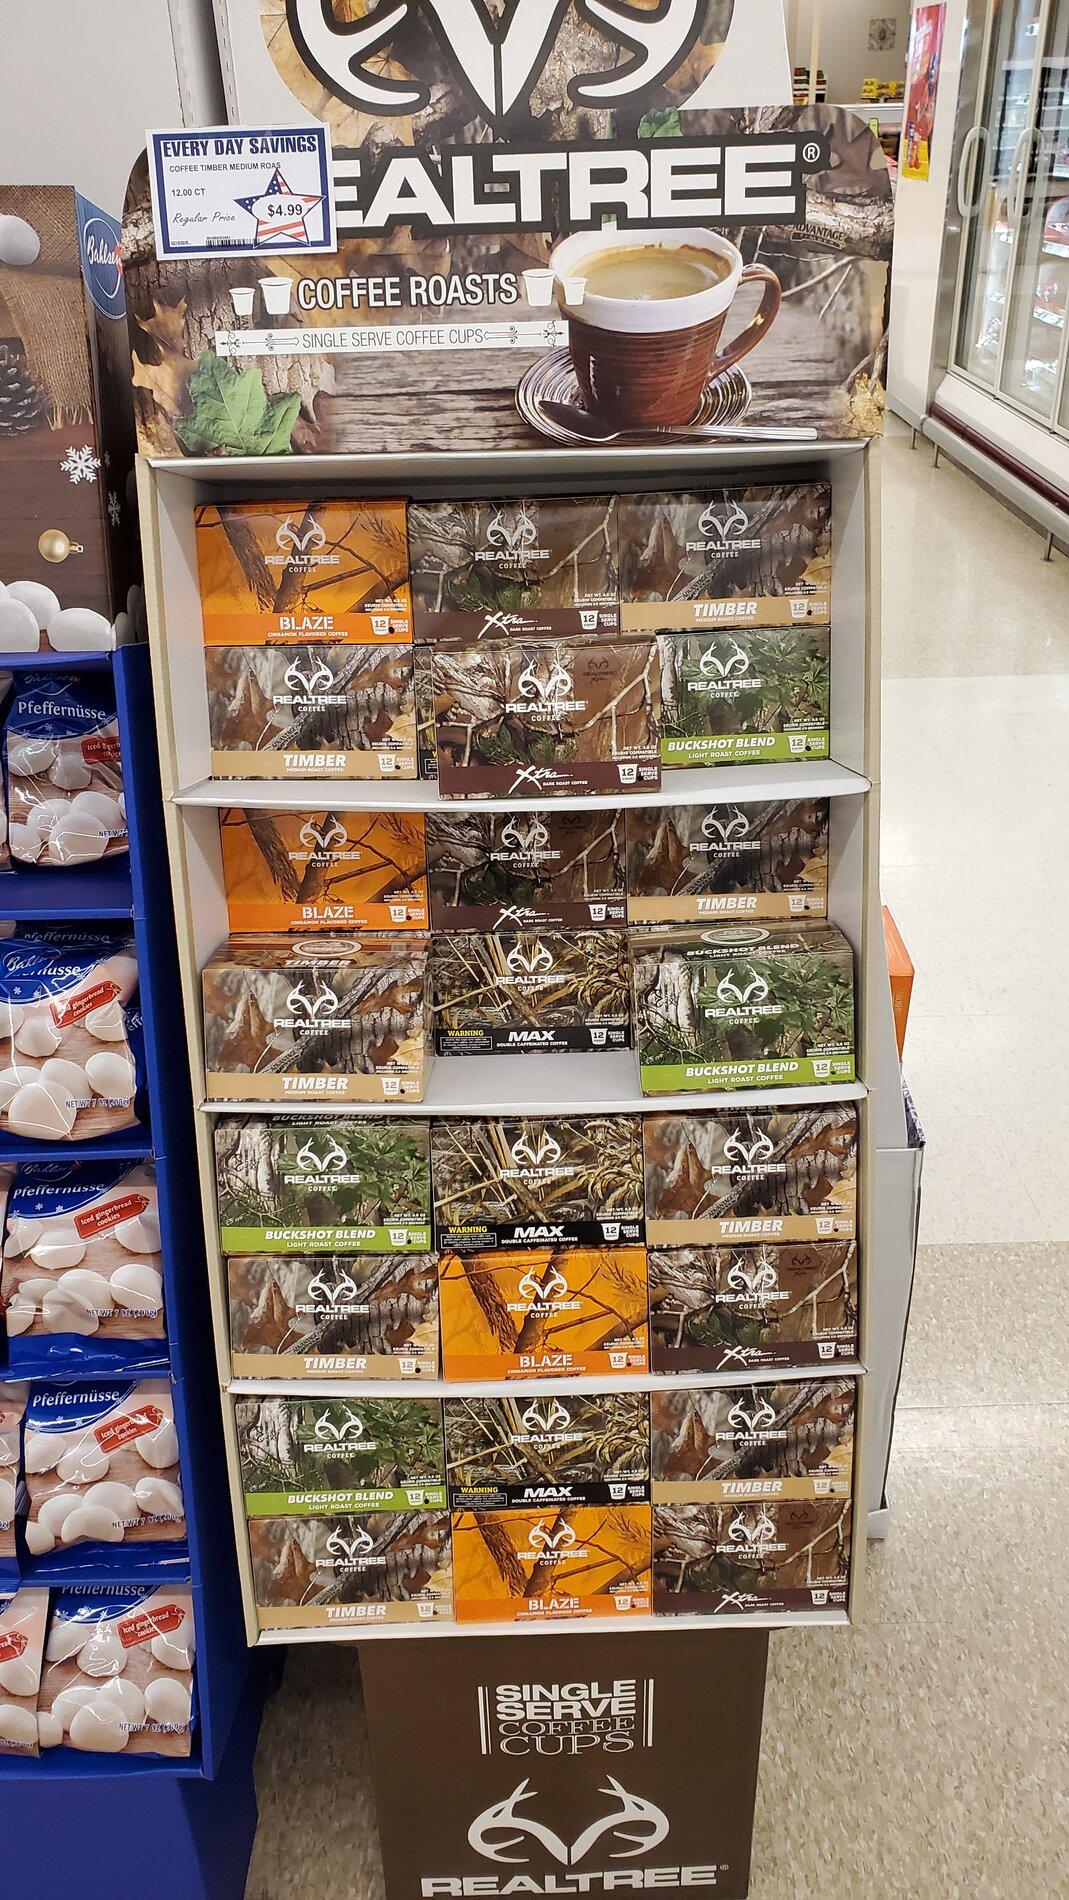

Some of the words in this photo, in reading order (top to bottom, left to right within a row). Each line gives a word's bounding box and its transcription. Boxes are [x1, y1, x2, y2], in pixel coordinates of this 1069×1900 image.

[162, 140, 209, 157] EVERY
[214, 139, 243, 156] DAY
[250, 136, 317, 154] SAVINGS
[194, 188, 205, 196] CT
[332, 143, 820, 231] EALTREE®
[268, 204, 302, 217] $4.99
[173, 211, 208, 226] Regular
[212, 211, 235, 221] Price
[298, 278, 400, 310] COFFEE
[410, 273, 519, 306] ROASTS
[302, 333, 347, 349] SINGLE
[352, 332, 394, 347] SERVE
[396, 331, 447, 345] COFFEE
[449, 329, 483, 344] CUPS
[686, 540, 761, 551] REALTREE
[265, 555, 340, 564] REALTREE
[475, 550, 550, 560] REALTREE
[693, 602, 757, 616] TIMBER
[793, 602, 805, 610] 12
[279, 616, 334, 630] BLAZE
[374, 620, 386, 628] 12
[477, 611, 538, 639] Xtra
[687, 679, 761, 691] REALTREE
[273, 696, 346, 704] REALTREE
[18, 701, 106, 719] Pfeffernüsse
[506, 701, 586, 713] REALTREE
[668, 739, 735, 750] BUCKSHOT
[737, 737, 776, 747] BLEND
[284, 755, 346, 766] TIMBER
[621, 768, 634, 776] 12
[508, 765, 573, 794] Xtra
[690, 842, 761, 851] REALTREE
[289, 852, 360, 860] REALTREE
[491, 851, 560, 861] REALTREE
[696, 897, 758, 910] TIMBER
[302, 906, 354, 919] BLAZE
[493, 905, 550, 930] Xtra
[687, 947, 756, 956] BUCKSHOT
[496, 976, 565, 984] REALTREE
[705, 1006, 782, 1018] REALTREE
[274, 1019, 351, 1028] REALTREE
[509, 1031, 555, 1041] MAX
[686, 1064, 754, 1077] BUCKSHOT
[757, 1062, 798, 1072] BLEND
[282, 1078, 348, 1090] TIMBER
[500, 1167, 574, 1178] REALTREE
[712, 1164, 786, 1174] REALTREE
[284, 1175, 359, 1184] REALTREE
[81, 1217, 94, 1225] Iced
[96, 1200, 132, 1218] gingerbread
[97, 1213, 120, 1226] cookies
[514, 1226, 564, 1238] MAX
[720, 1220, 783, 1234] TIMBER
[266, 1231, 333, 1240] BUCKSHOT
[336, 1230, 376, 1239] BLEND
[716, 1292, 789, 1303] REALTREE
[296, 1305, 369, 1313] REALTREE
[507, 1301, 580, 1311] REALTREE
[304, 1358, 367, 1370] TIMBER
[520, 1354, 573, 1368] BLAZE
[716, 1346, 776, 1371] Xtra
[33, 1391, 119, 1407] Pfeffernüsse
[101, 1430, 113, 1438] Iced
[511, 1433, 583, 1443] REALTREE
[716, 1431, 787, 1440] REALTREE
[304, 1442, 377, 1452] REALTREE
[524, 1486, 573, 1498] MAX
[722, 1481, 783, 1493] TIMBER
[288, 1494, 354, 1504] BUCKSHOT
[356, 1492, 394, 1501] BLEND
[716, 1544, 786, 1553] REALTREE
[517, 1550, 587, 1560] REALTREE
[316, 1557, 386, 1566] REALTREE
[529, 1598, 579, 1610] BLAZE
[713, 1592, 771, 1613] Xtra
[326, 1606, 387, 1618] TIMBER
[495, 1680, 636, 1701] SINGLE
[496, 1697, 636, 1721] SERVE
[499, 1716, 635, 1736] COFFEE
[500, 1732, 634, 1755] CUPS
